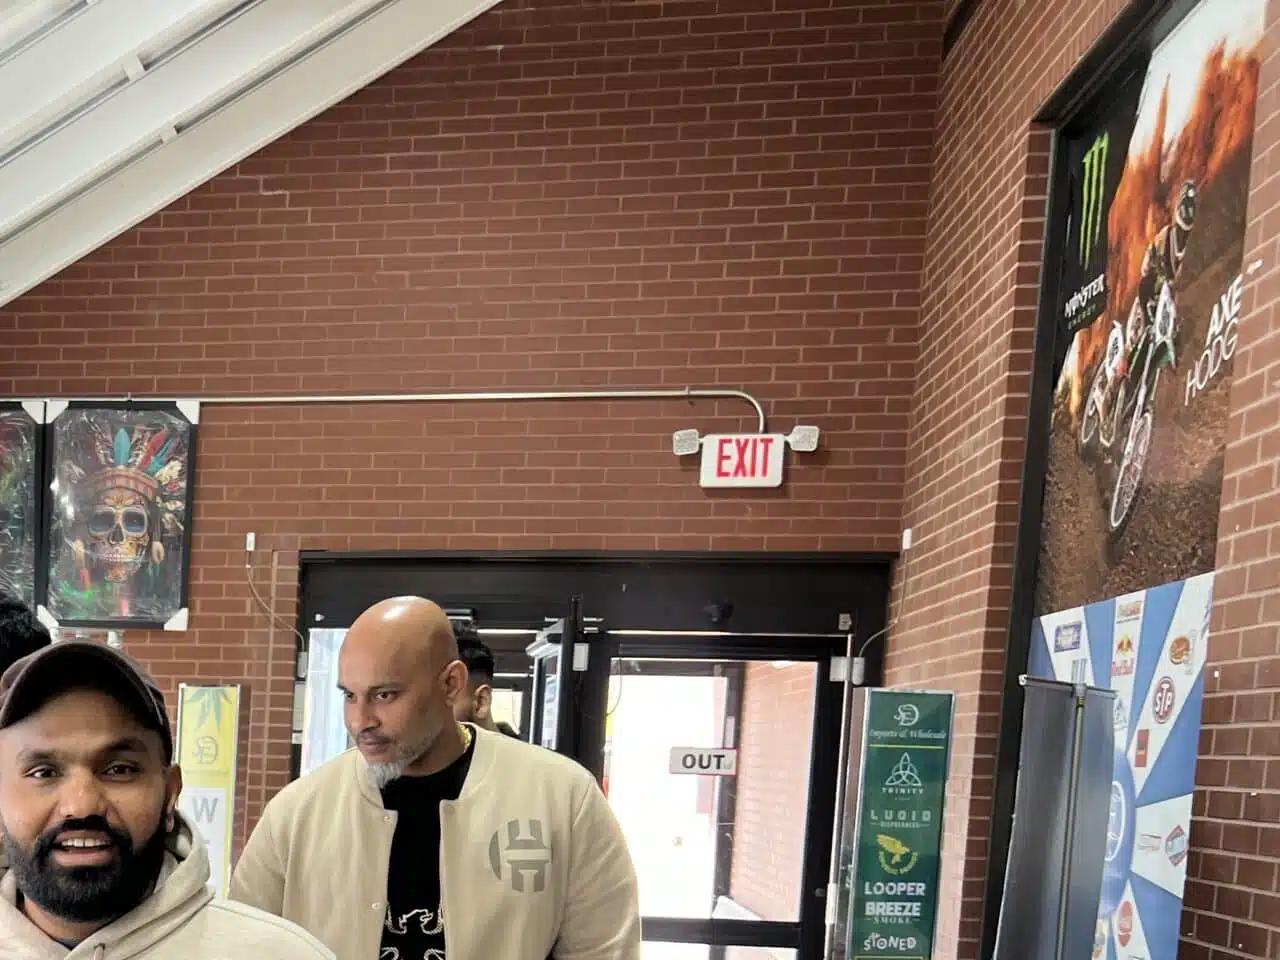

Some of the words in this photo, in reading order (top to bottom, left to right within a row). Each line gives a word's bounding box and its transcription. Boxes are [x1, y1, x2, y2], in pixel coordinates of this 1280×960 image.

[1064, 273, 1105, 318] MONSTER
[716, 438, 774, 478] EXIT
[682, 753, 725, 770] OUT
[864, 881, 926, 896] LOOPER
[865, 902, 921, 917] BREEZE
[864, 932, 917, 951] STONED
